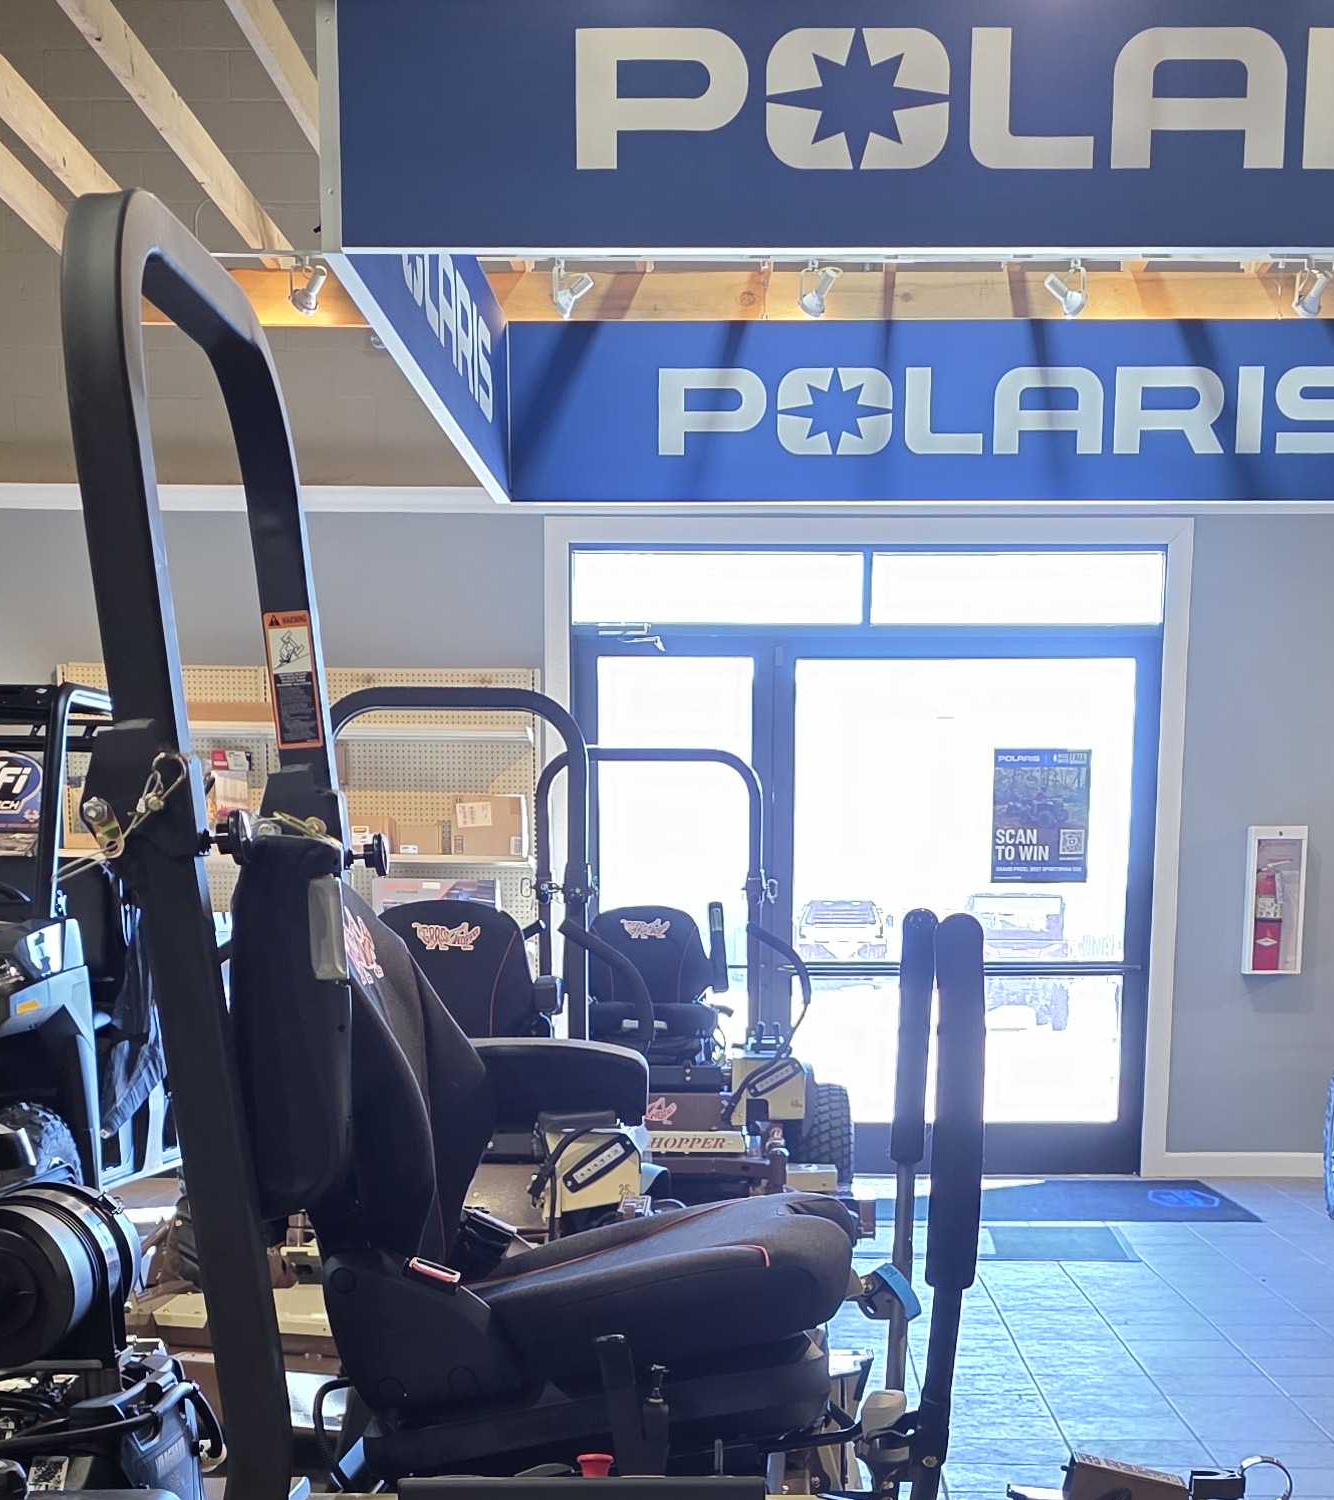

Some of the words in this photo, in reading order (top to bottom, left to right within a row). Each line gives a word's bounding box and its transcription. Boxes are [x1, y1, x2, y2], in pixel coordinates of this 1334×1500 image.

[401, 254, 493, 423] OLARIS
[995, 828, 1038, 845] SCAN
[995, 845, 1015, 861] TO
[1018, 845, 1049, 861] WIN
[649, 1136, 727, 1150] HOPPER
[618, 1183, 631, 1197] 25
